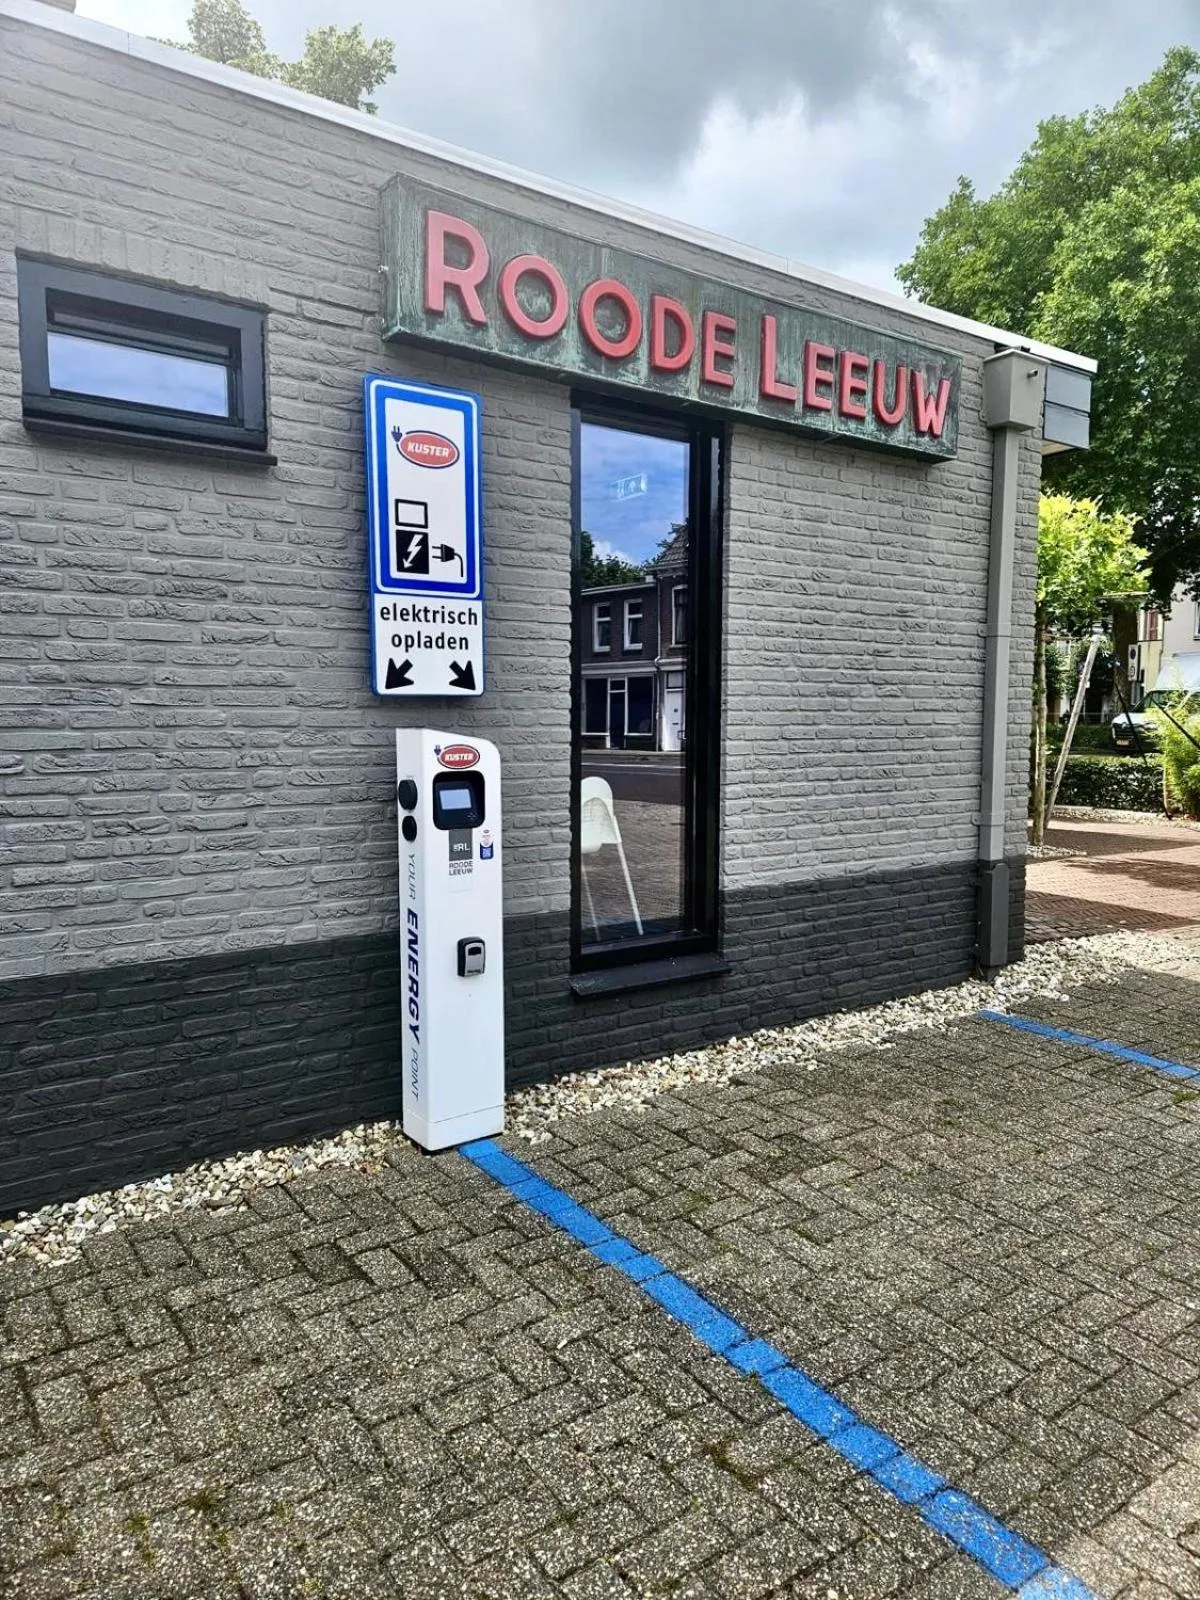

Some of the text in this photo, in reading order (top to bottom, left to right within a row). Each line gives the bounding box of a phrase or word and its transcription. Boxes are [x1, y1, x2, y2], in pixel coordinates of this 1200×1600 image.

[424, 210, 951, 437] ROODE LEEUW
[407, 442, 450, 457] KUSTER
[380, 602, 478, 626] elektrisch
[391, 630, 469, 653] opladen
[444, 753, 474, 761] KUSTER
[407, 853, 420, 1102] YOUR ENERGY POINT
